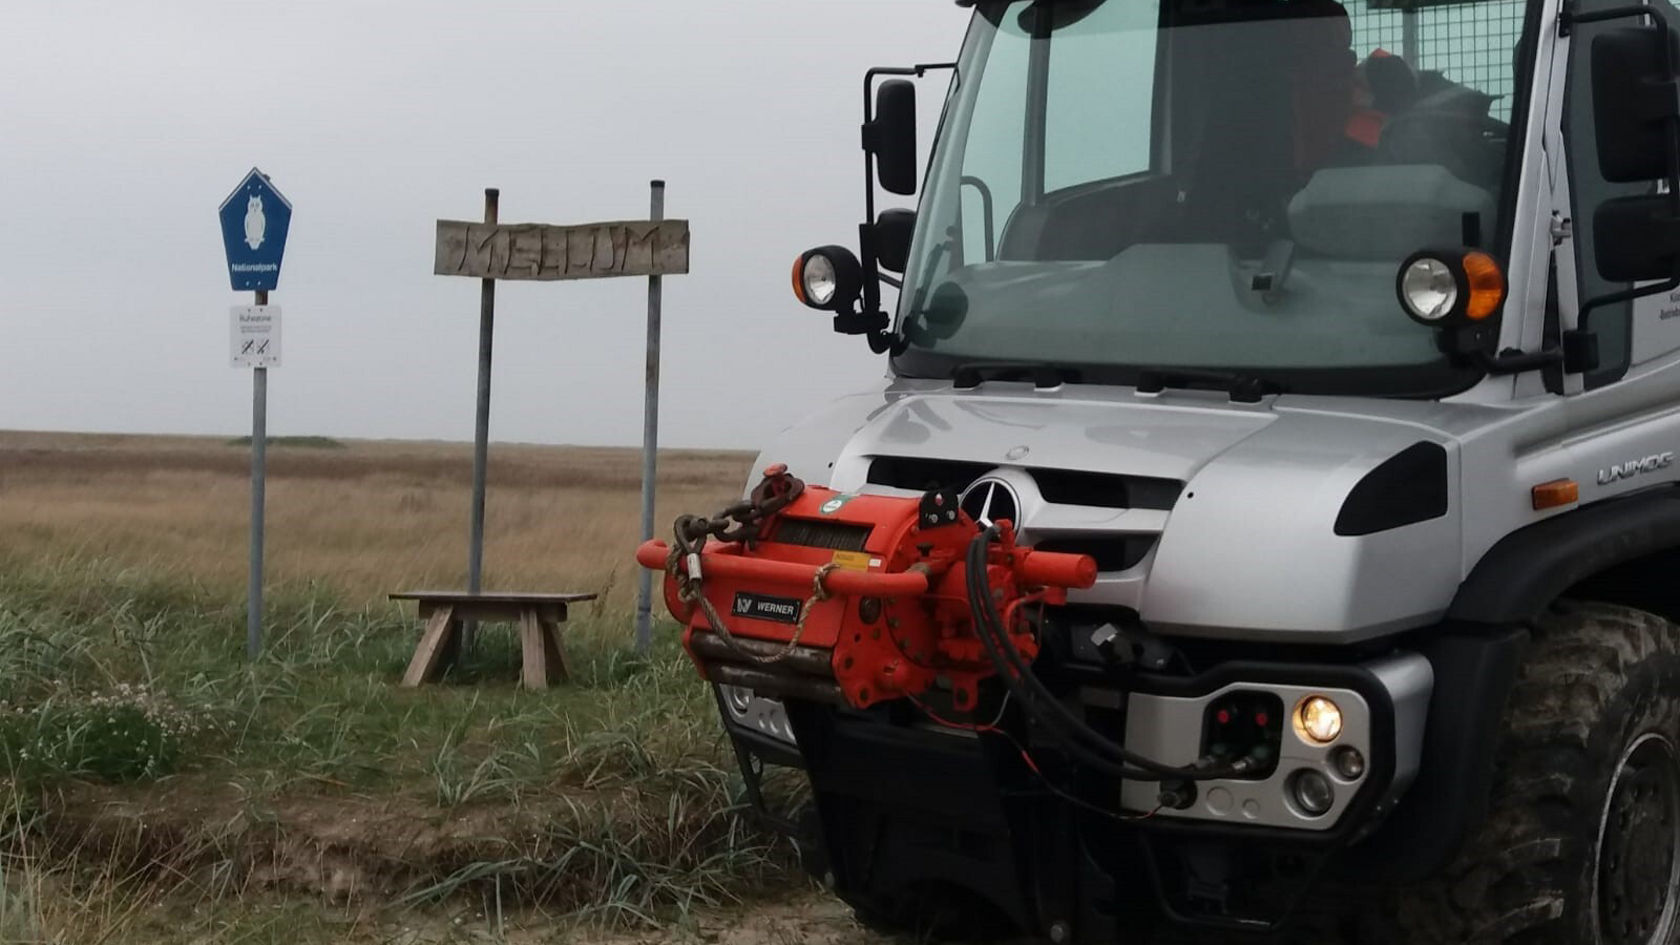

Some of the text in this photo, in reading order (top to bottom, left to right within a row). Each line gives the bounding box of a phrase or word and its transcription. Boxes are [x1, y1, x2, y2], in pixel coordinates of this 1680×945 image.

[231, 263, 278, 272] Nationalpark
[1597, 452, 1674, 484] UNIMOG
[757, 602, 794, 615] WERNER
